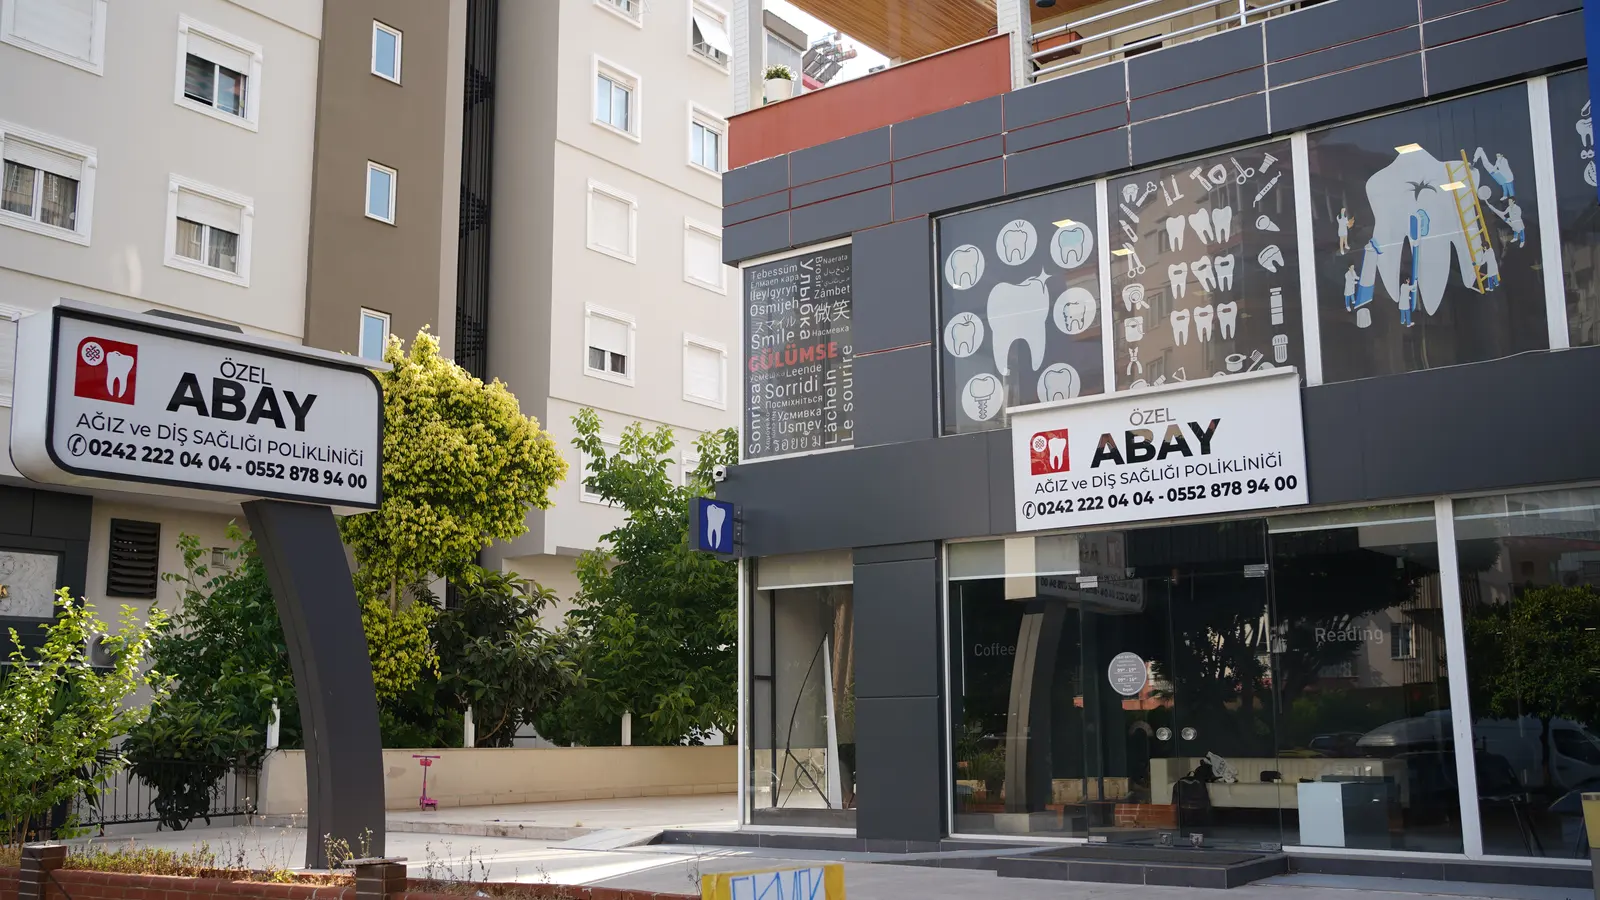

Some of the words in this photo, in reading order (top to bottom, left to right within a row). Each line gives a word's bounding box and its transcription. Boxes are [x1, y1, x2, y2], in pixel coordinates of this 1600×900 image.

[822, 254, 848, 264] Naerata
[751, 264, 798, 280] Tebessüm
[750, 296, 799, 317] Osmijeh
[814, 299, 850, 324] 微笑
[755, 316, 797, 334] スマイル
[751, 328, 795, 350] Smile
[748, 341, 838, 372] GÜLÜMSE
[220, 358, 272, 386] ÖZEL
[786, 364, 822, 378] Leende
[839, 345, 854, 412] sourire
[765, 374, 818, 400] Sorridi
[166, 372, 318, 432] ABAY
[823, 368, 838, 445] Lächeln
[748, 383, 760, 454] Sonrisa
[778, 420, 822, 434] Usmev
[1129, 407, 1176, 427] ÖZEL
[76, 412, 125, 434] AĞIZ
[130, 422, 151, 438] ve
[157, 422, 188, 447] DİŞ
[193, 428, 262, 454] SAĞLIĞI
[268, 440, 364, 467] POLİKLİNİĞİ
[841, 419, 854, 442] Le
[1090, 418, 1221, 468] ABAY
[88, 438, 136, 462] 0242
[141, 446, 174, 464] 222
[180, 452, 203, 468] 04
[208, 455, 232, 472] 04
[246, 460, 284, 479] 0552
[289, 465, 320, 484] 878
[323, 470, 344, 486] 94
[348, 473, 368, 489] 00
[1034, 478, 1068, 494] AĞIZ
[1072, 478, 1088, 490] ve
[1092, 473, 1117, 489] DİŞ
[1120, 464, 1180, 485] SAĞLIĞI
[1185, 451, 1282, 478] POLİKLİNİĞİ
[1037, 499, 1074, 516] 0242
[1077, 496, 1104, 512] 222
[1108, 493, 1128, 508] 04
[1132, 490, 1154, 506] 04
[1167, 484, 1206, 502] 0552
[1210, 480, 1243, 498] 878
[1247, 476, 1270, 494] 94
[1274, 474, 1298, 492] 00
[1314, 626, 1384, 644] Reading
[974, 642, 1016, 656] Coffee
